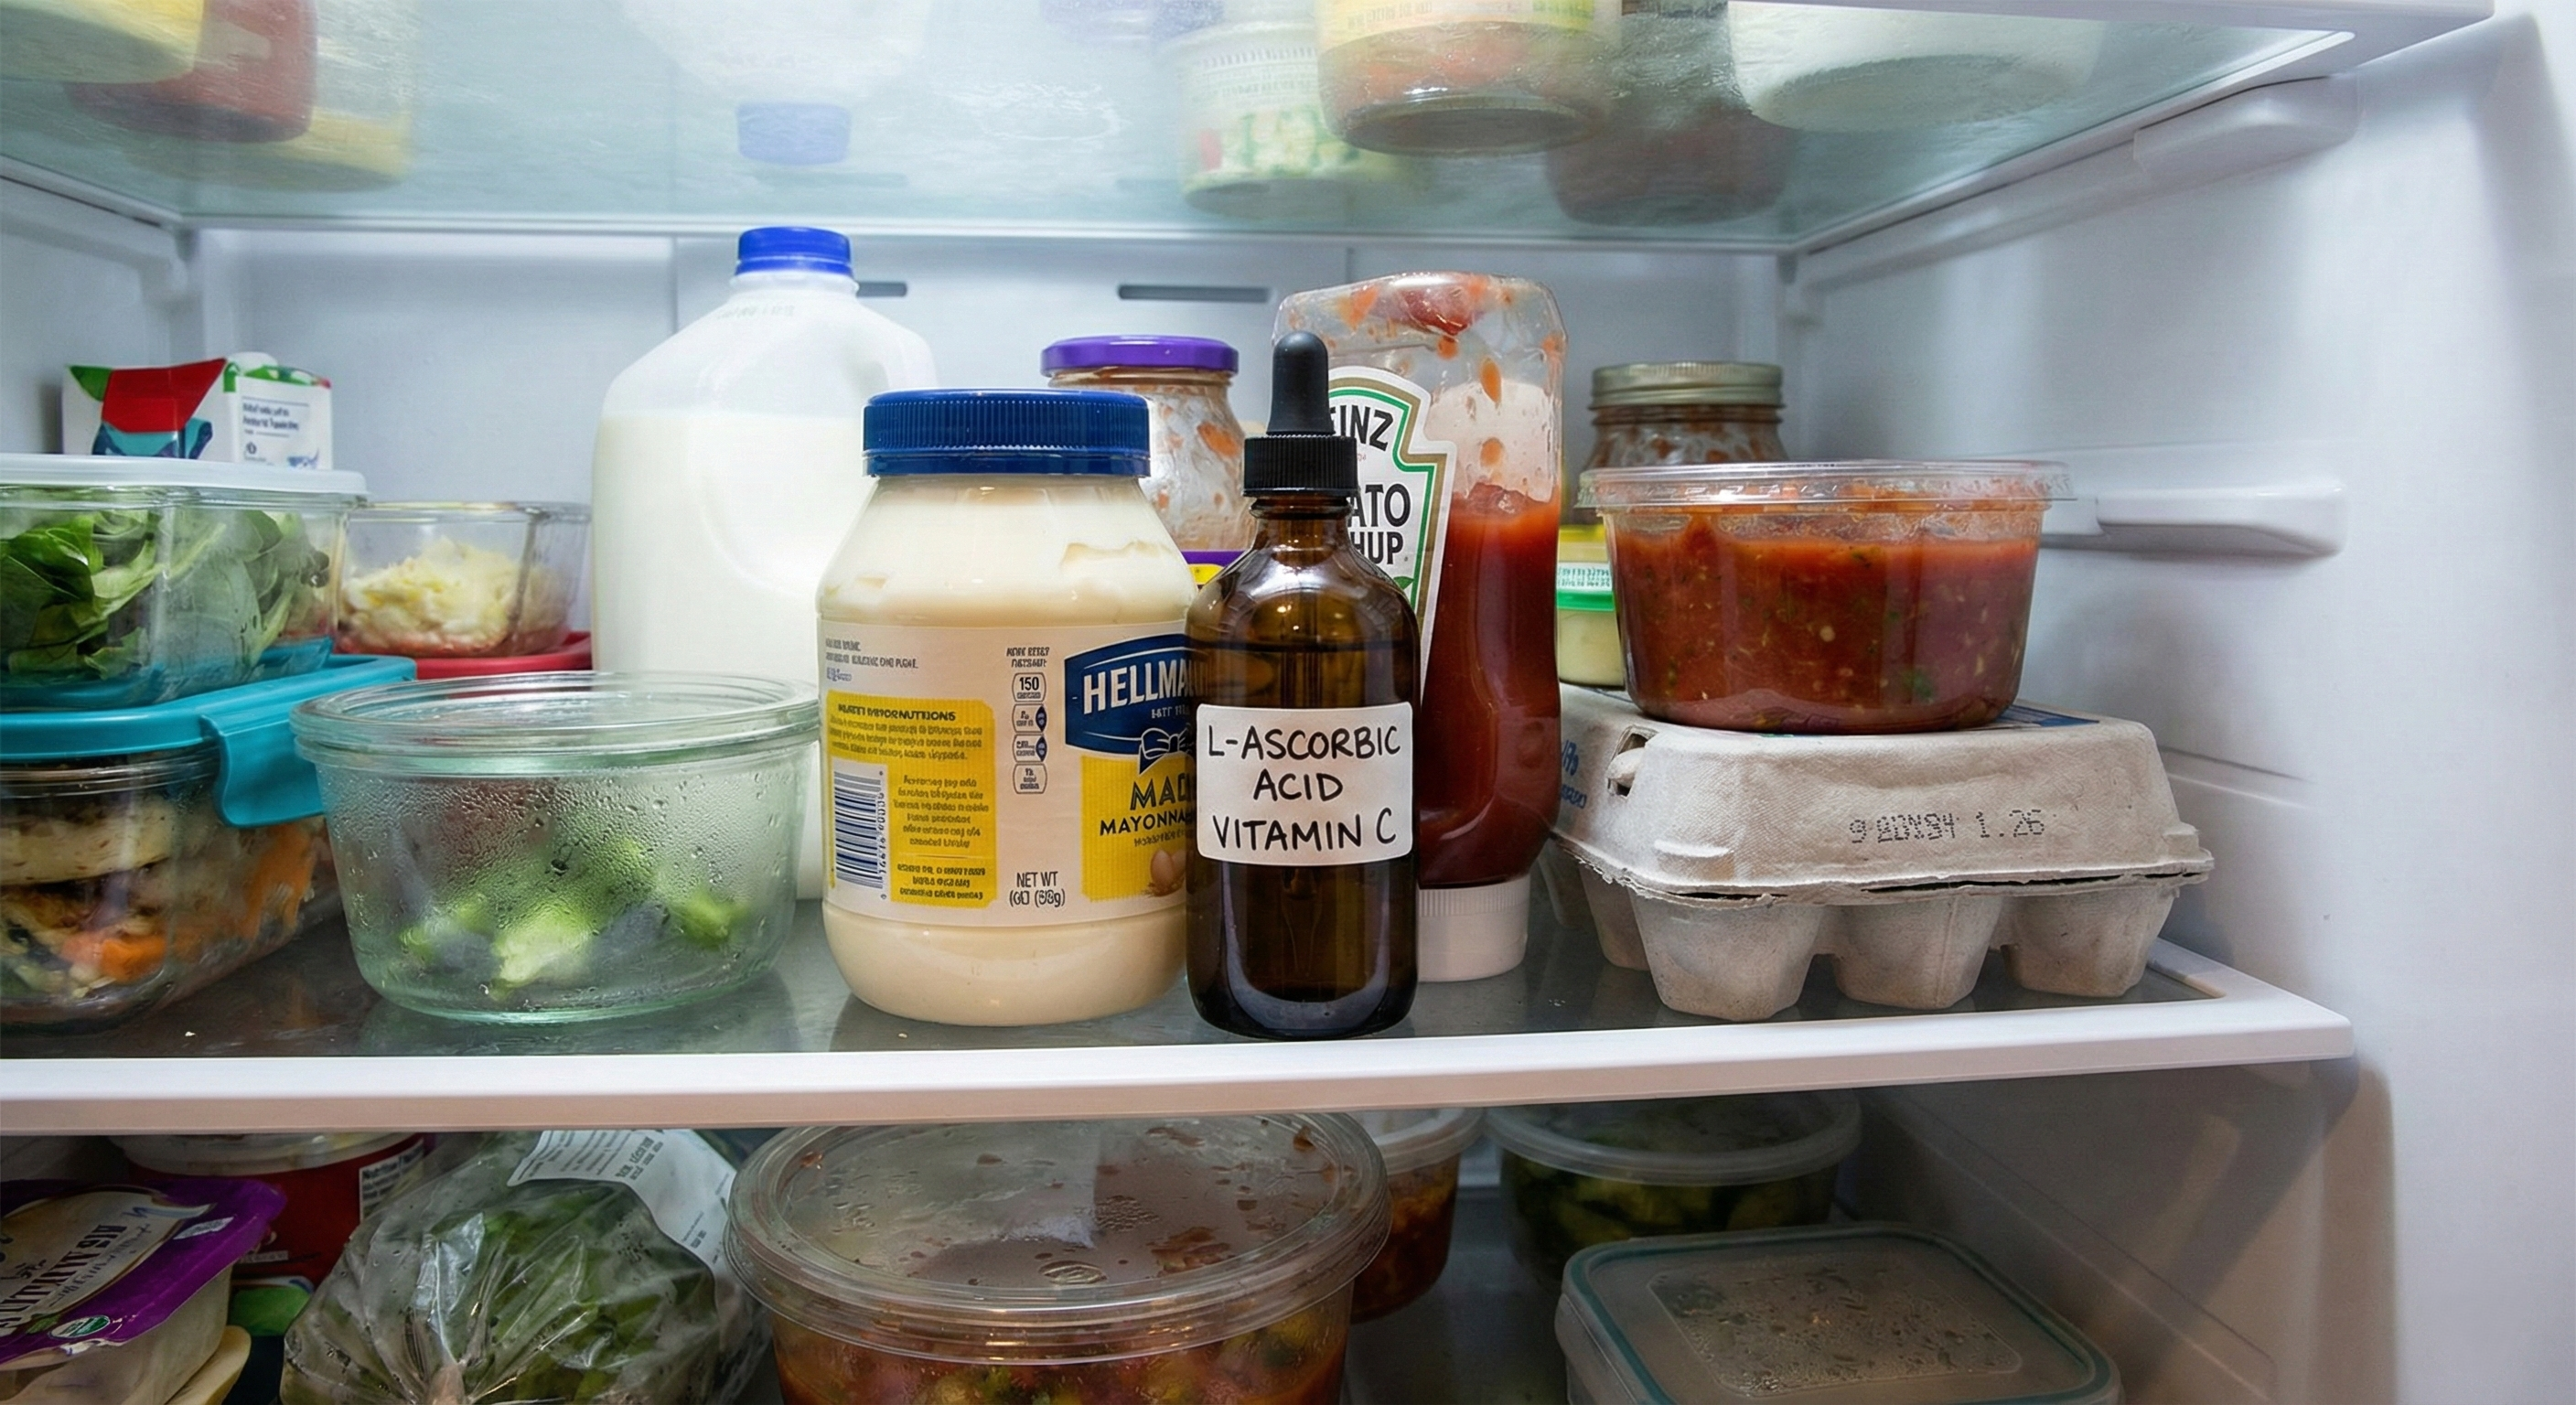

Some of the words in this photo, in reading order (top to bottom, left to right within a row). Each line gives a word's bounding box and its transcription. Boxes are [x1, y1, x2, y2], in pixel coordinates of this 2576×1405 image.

[1019, 676, 1040, 691] 150
[1208, 725, 1401, 760] L-ASCORBIC
[1253, 768, 1344, 801] ACID
[1212, 814, 1362, 852] VITAMIN
[1375, 807, 1397, 844] C
[1016, 872, 1038, 887] NET
[1040, 871, 1058, 886] WT
